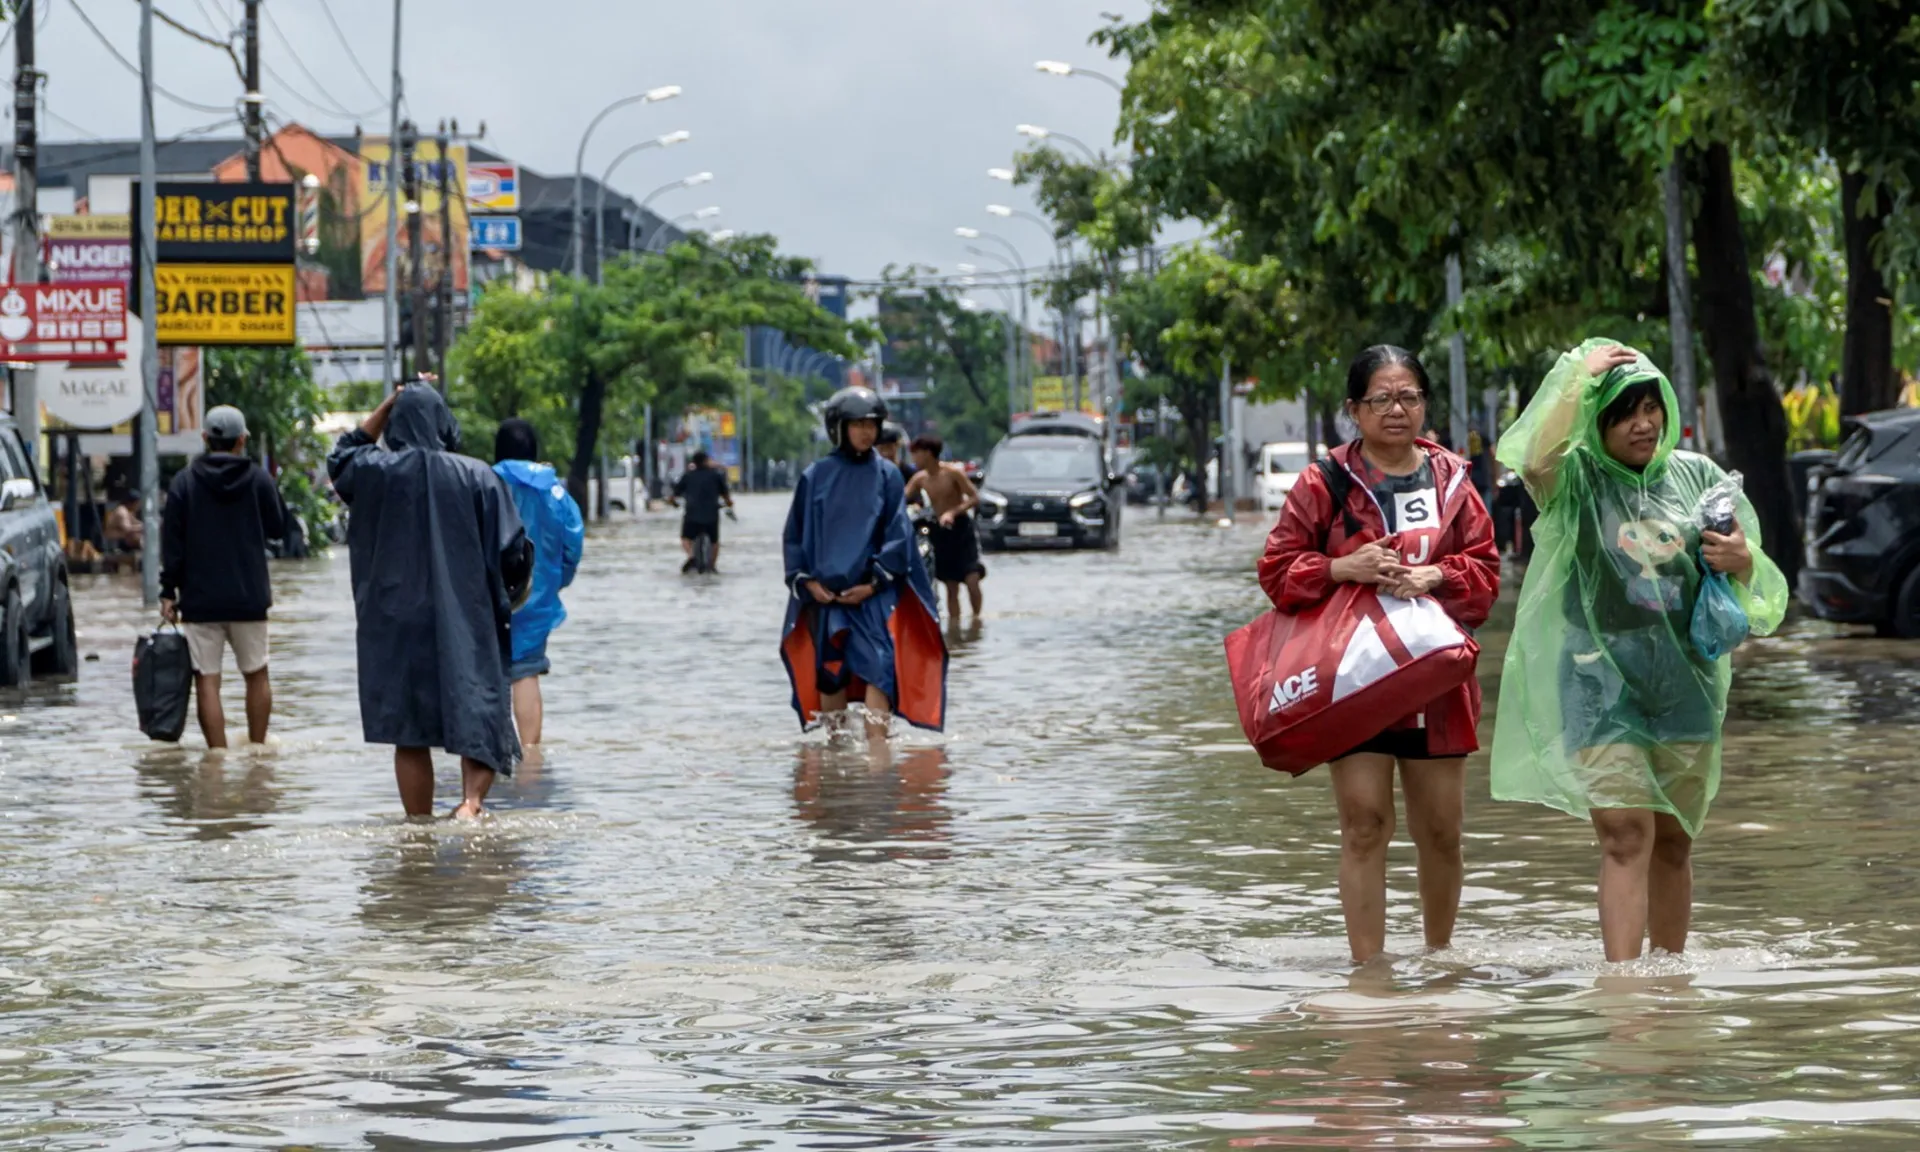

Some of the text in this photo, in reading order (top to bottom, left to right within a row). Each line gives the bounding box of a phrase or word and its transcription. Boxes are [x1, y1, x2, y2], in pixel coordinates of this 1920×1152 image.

[231, 195, 288, 222] CUT
[35, 288, 122, 312] MIXUE
[155, 289, 285, 315] BARBER
[1404, 497, 1429, 523] S
[1406, 535, 1429, 564] J
[1268, 666, 1320, 711] ACE
